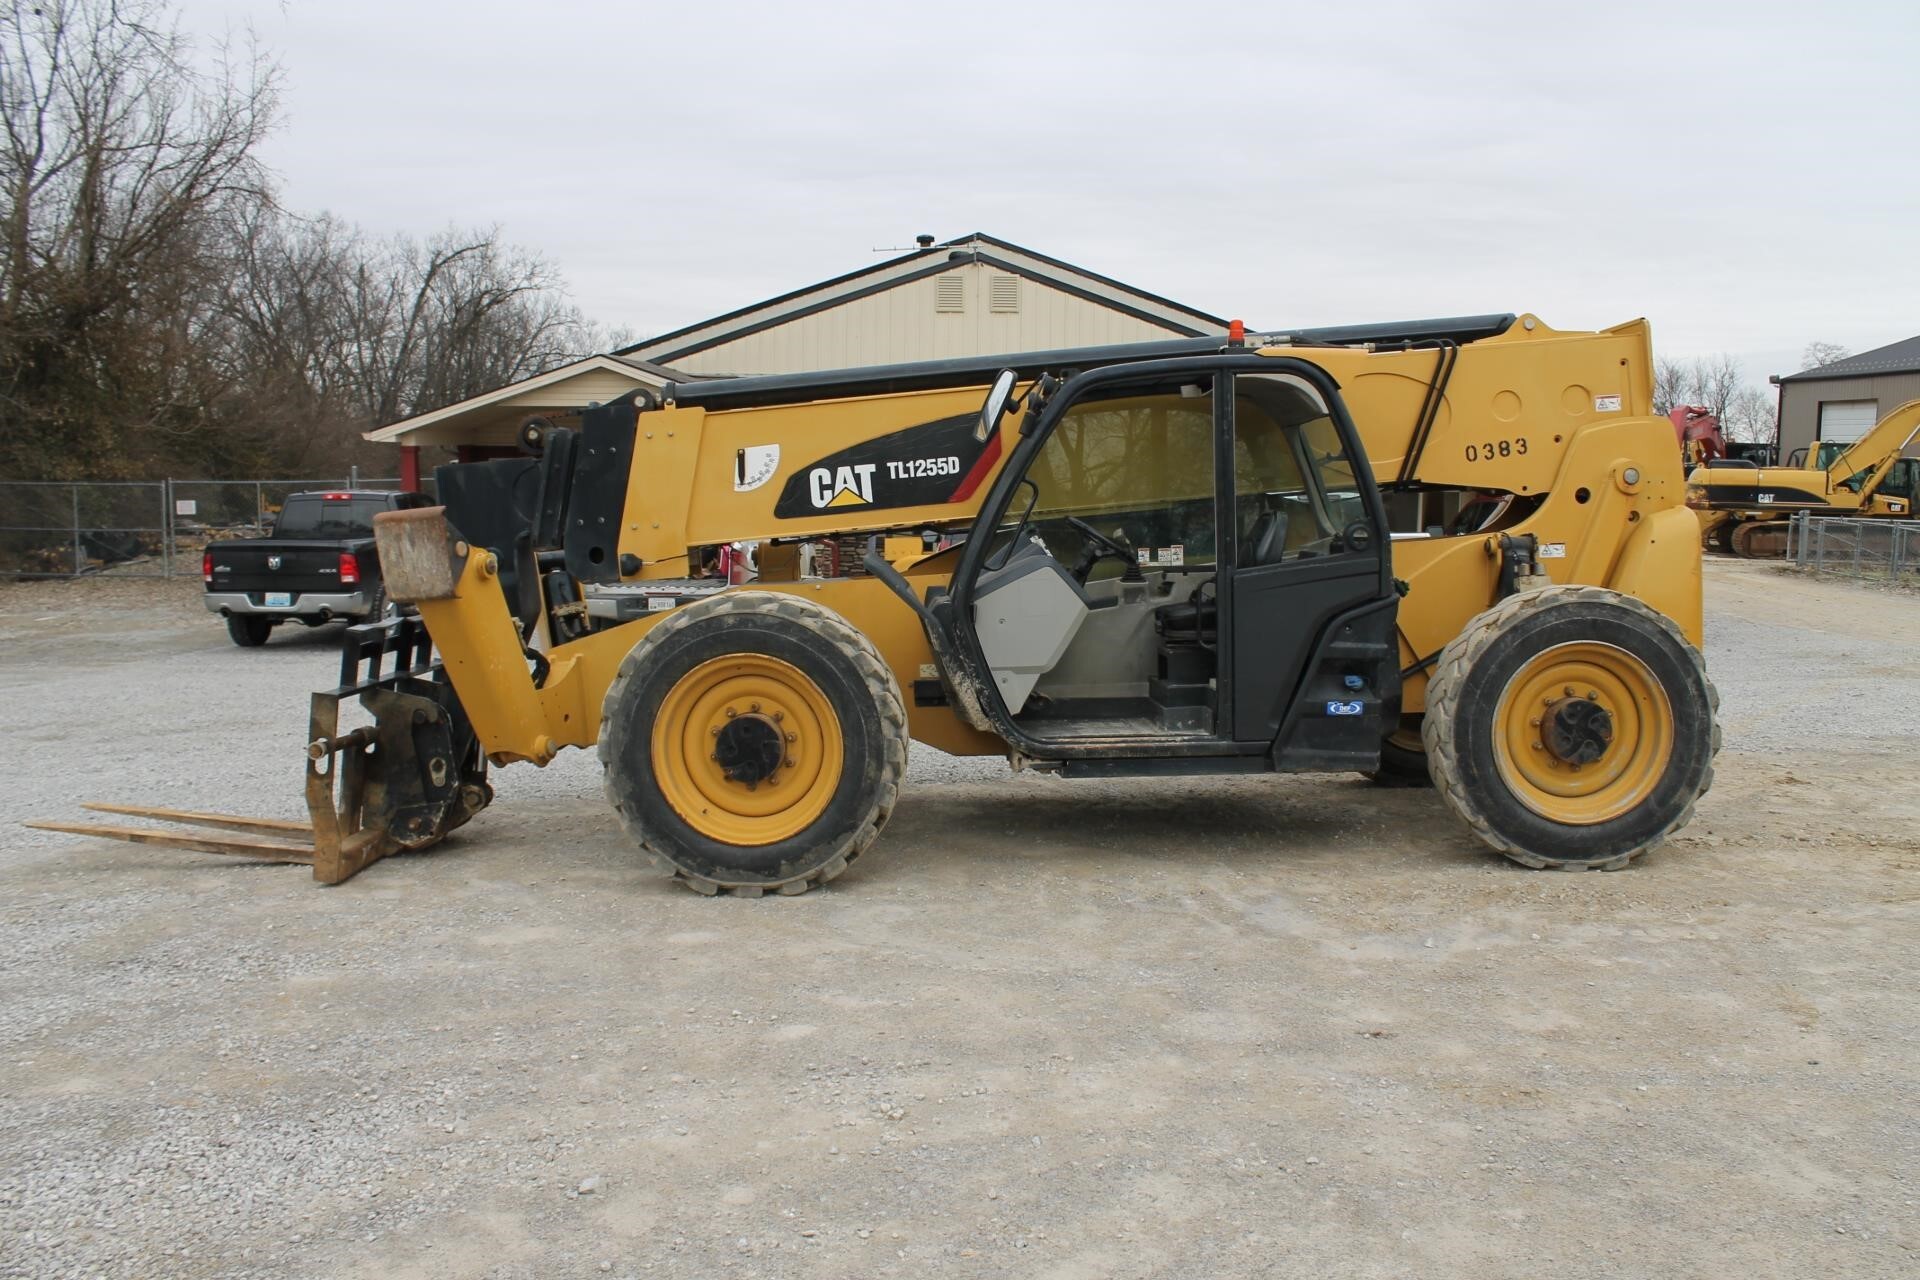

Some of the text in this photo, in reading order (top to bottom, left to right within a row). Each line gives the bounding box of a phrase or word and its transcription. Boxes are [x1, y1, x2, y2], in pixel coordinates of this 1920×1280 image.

[1465, 438, 1528, 462] 0383
[809, 463, 877, 508] CAT
[886, 456, 960, 480] TL1255D
[1758, 494, 1775, 503] CAT
